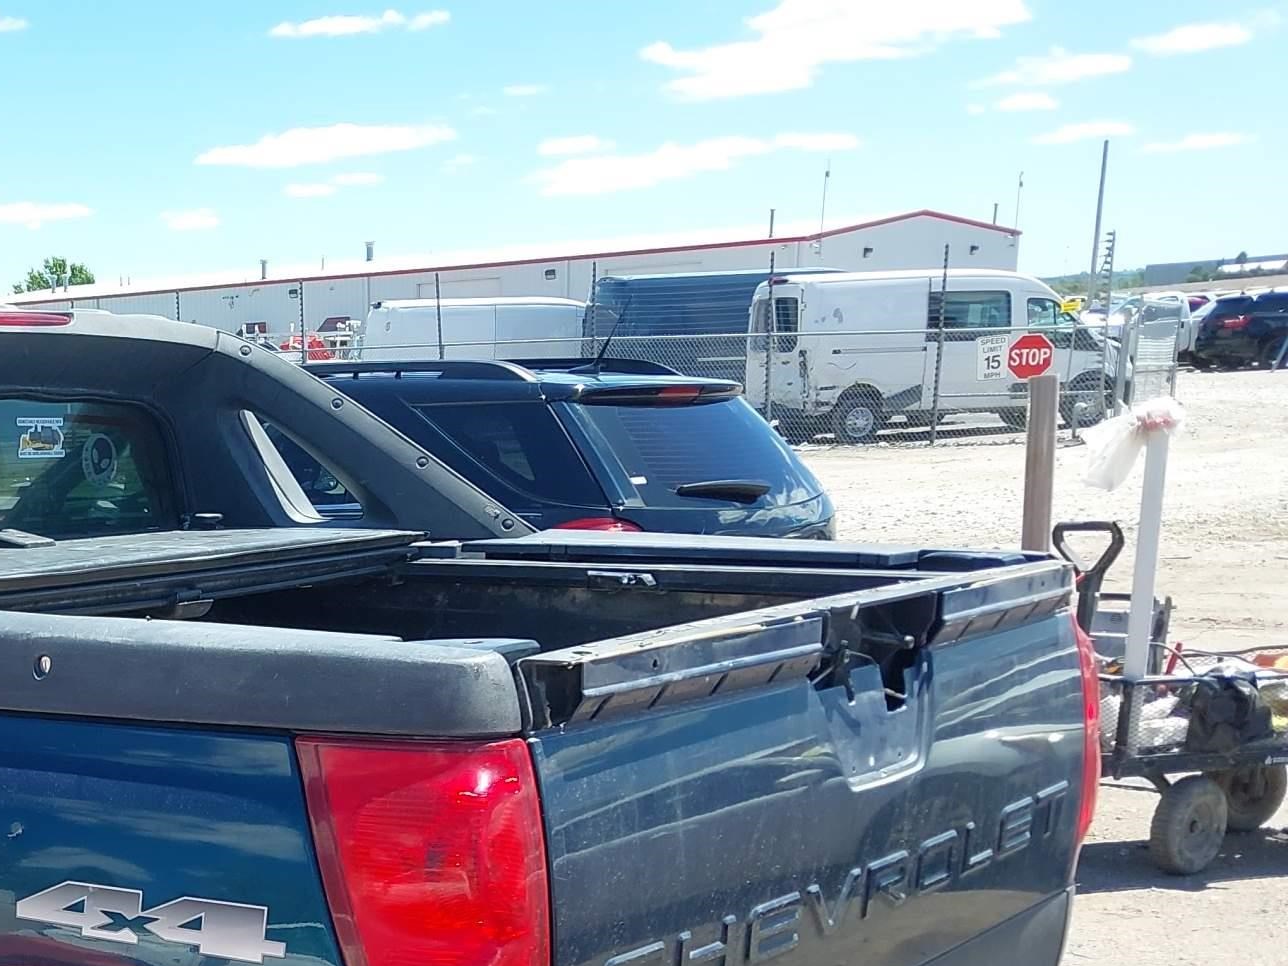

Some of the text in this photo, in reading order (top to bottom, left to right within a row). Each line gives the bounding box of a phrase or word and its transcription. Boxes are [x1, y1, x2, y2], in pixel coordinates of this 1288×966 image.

[980, 337, 1006, 345] SPEED
[984, 355, 1001, 370] 15
[1010, 348, 1050, 366] STOP
